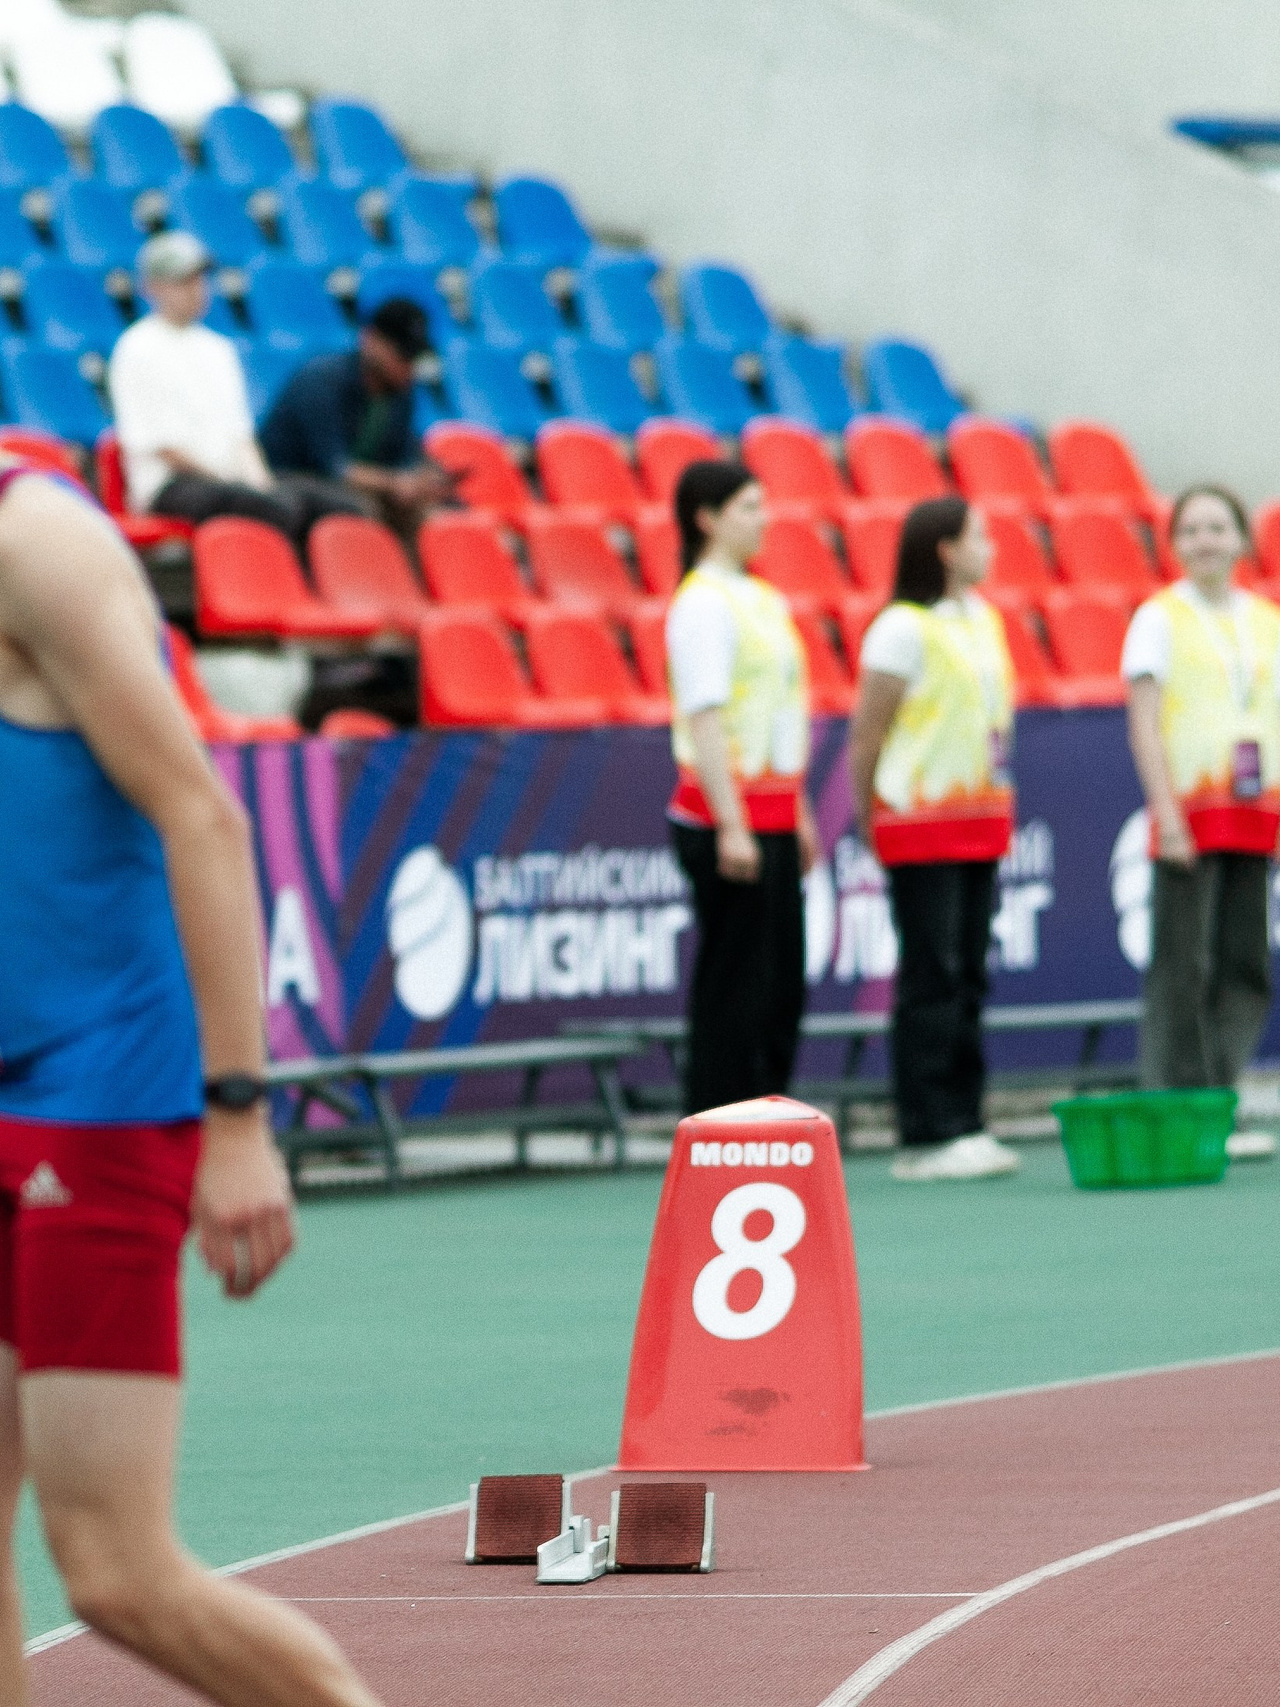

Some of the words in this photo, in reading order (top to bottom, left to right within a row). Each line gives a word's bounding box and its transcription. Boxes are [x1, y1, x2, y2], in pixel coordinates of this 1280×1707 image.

[473, 905, 695, 1007] ЛИЗИНГ
[690, 1141, 815, 1167] MONDO
[691, 1181, 807, 1340] 8
